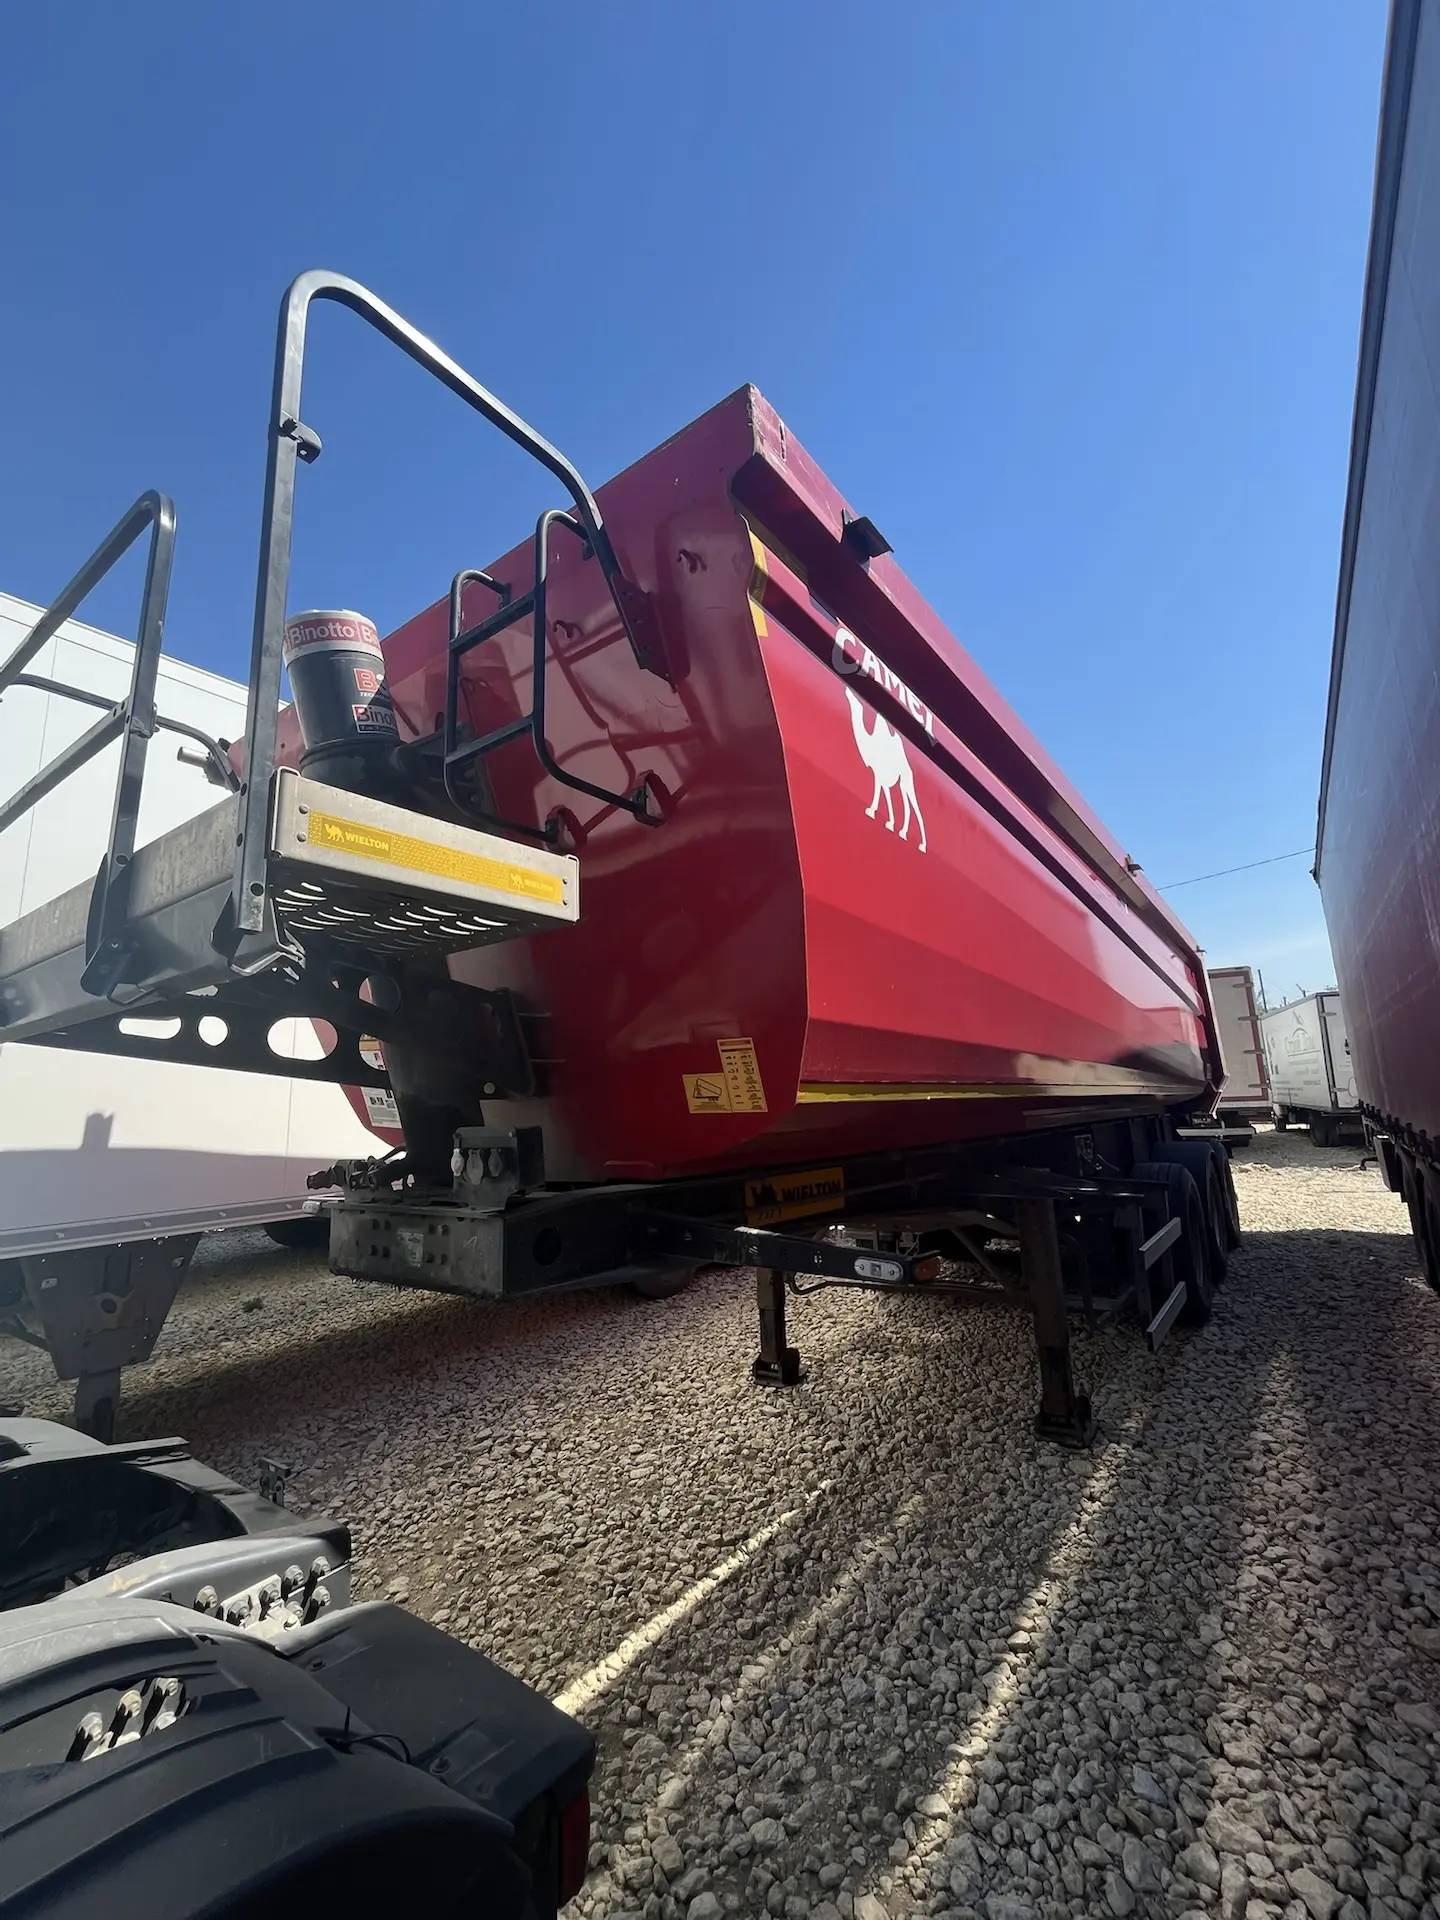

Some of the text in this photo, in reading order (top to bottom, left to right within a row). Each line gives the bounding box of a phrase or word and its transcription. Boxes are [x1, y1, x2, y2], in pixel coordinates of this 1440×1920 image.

[288, 622, 356, 644] Binotto
[356, 706, 394, 724] Bino
[345, 831, 389, 851] WIELTON
